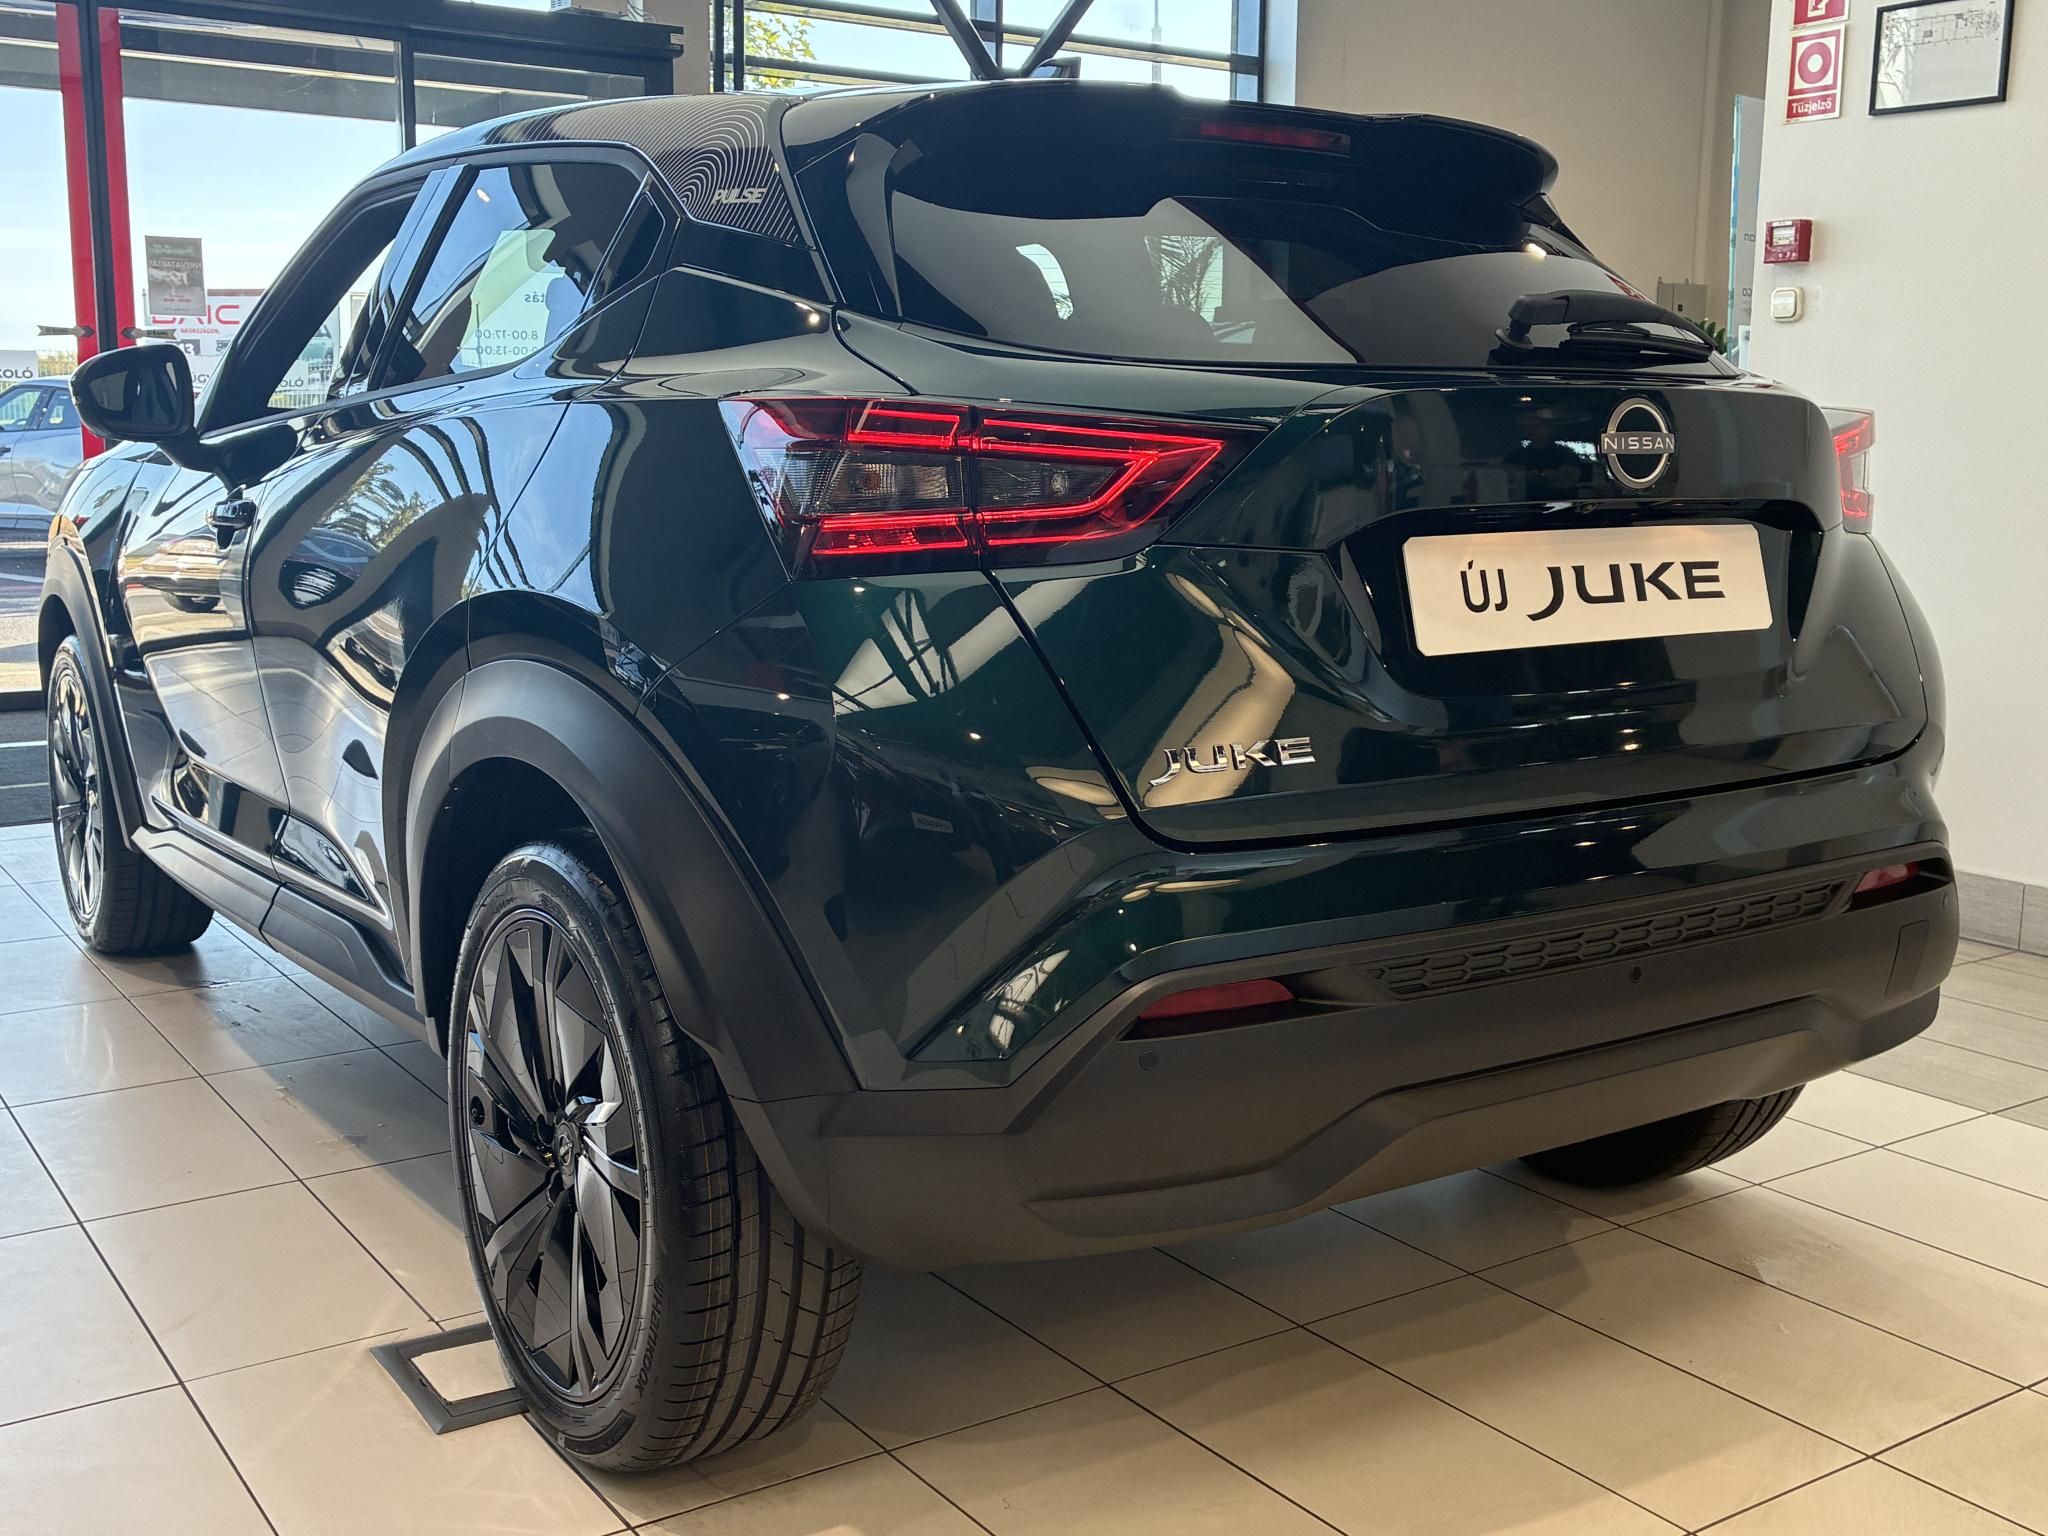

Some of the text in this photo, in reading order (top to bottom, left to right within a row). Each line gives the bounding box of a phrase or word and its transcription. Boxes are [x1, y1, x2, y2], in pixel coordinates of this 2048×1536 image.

[711, 187, 768, 204] PULSE
[1604, 436, 1675, 450] NISSAN
[1460, 559, 1726, 622] ÚJ JUKE
[1148, 736, 1316, 786] JUKE
